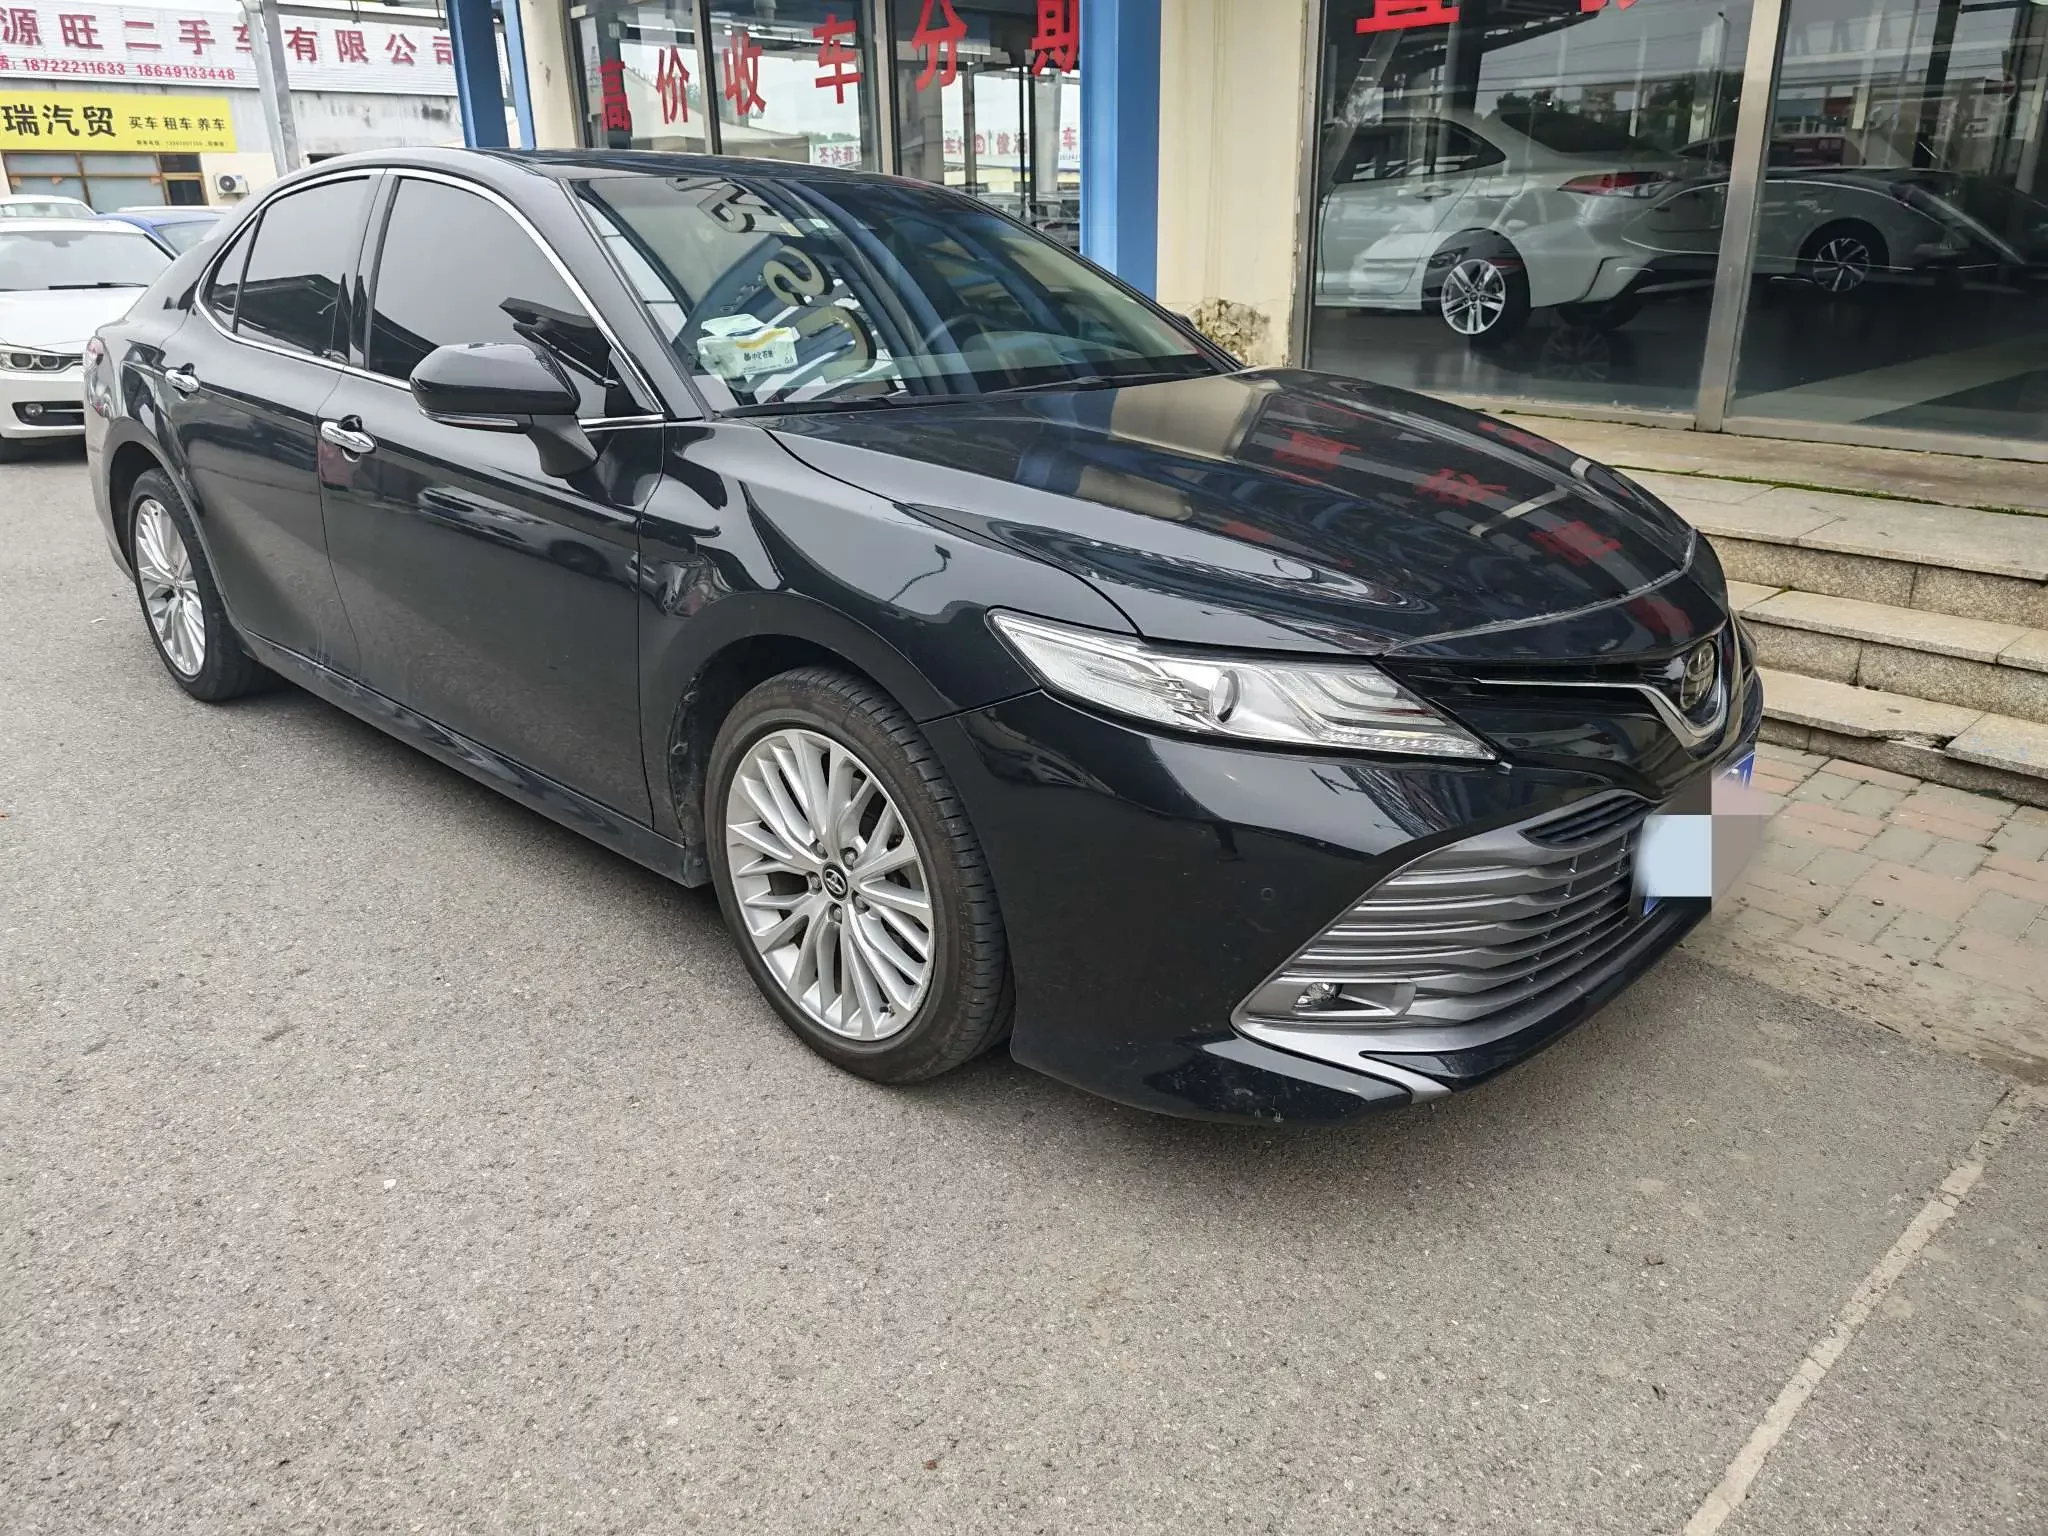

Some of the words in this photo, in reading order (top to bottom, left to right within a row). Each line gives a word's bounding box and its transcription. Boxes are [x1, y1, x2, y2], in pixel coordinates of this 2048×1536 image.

[136, 63, 236, 81] 18649133448
[1, 103, 116, 137] 瑞汽贸
